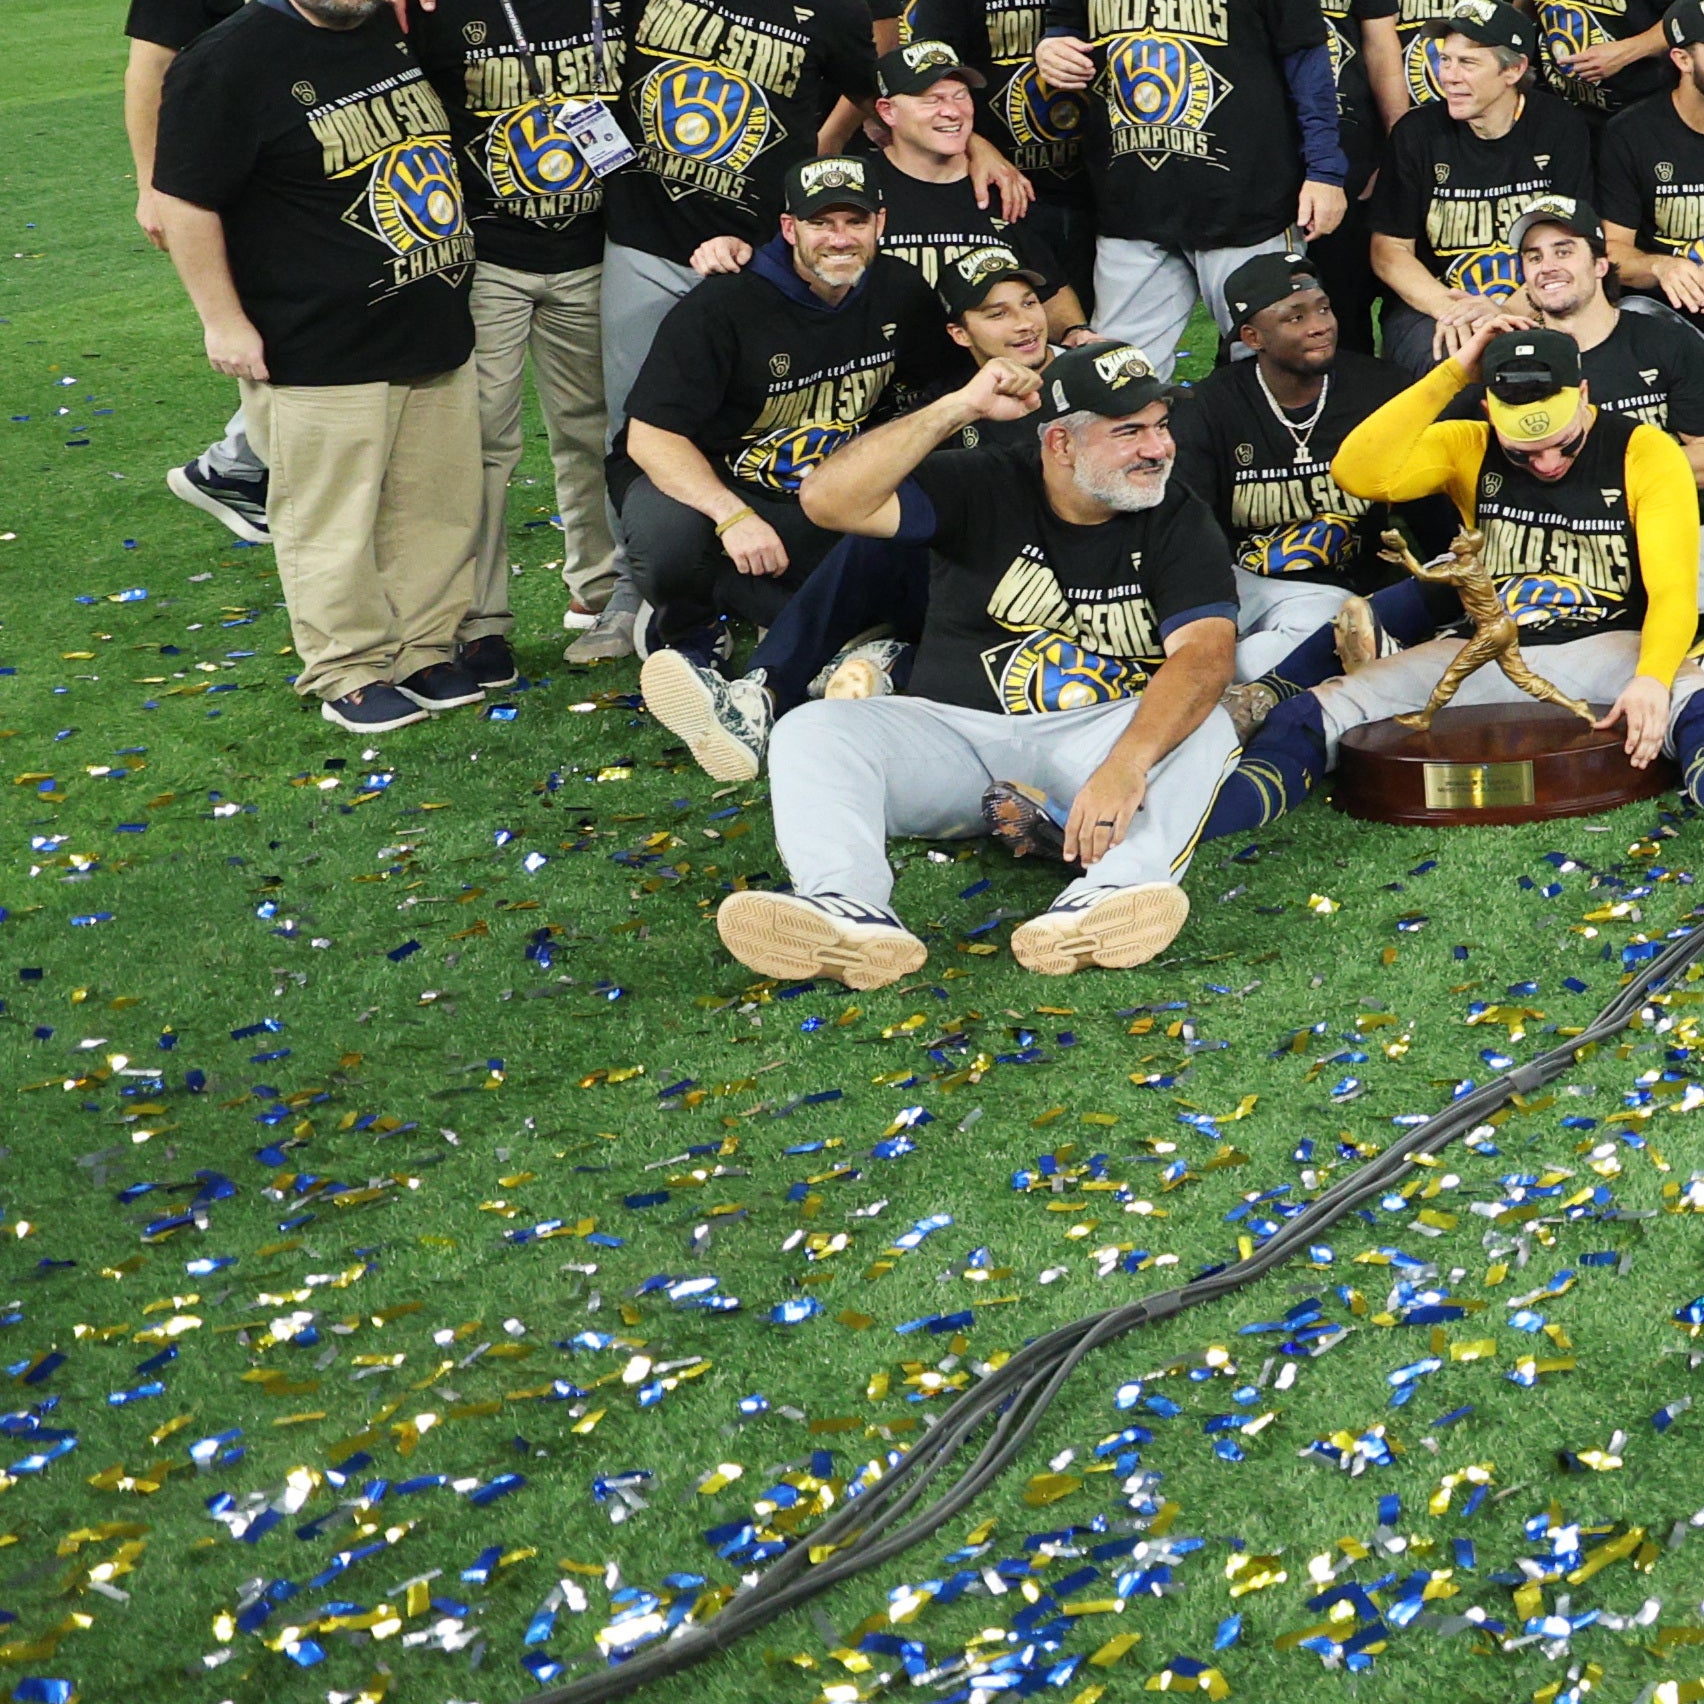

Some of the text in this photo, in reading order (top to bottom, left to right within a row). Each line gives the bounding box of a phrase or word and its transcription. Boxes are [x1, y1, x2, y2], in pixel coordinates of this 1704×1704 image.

[720, 22, 806, 98] SERIES
[902, 41, 958, 70] CHAMPIONS
[1187, 60, 1202, 128] BREWERS
[309, 99, 391, 176] WORLD
[637, 146, 746, 199] CHAMPIONS
[801, 158, 864, 189] CHAMPIONS
